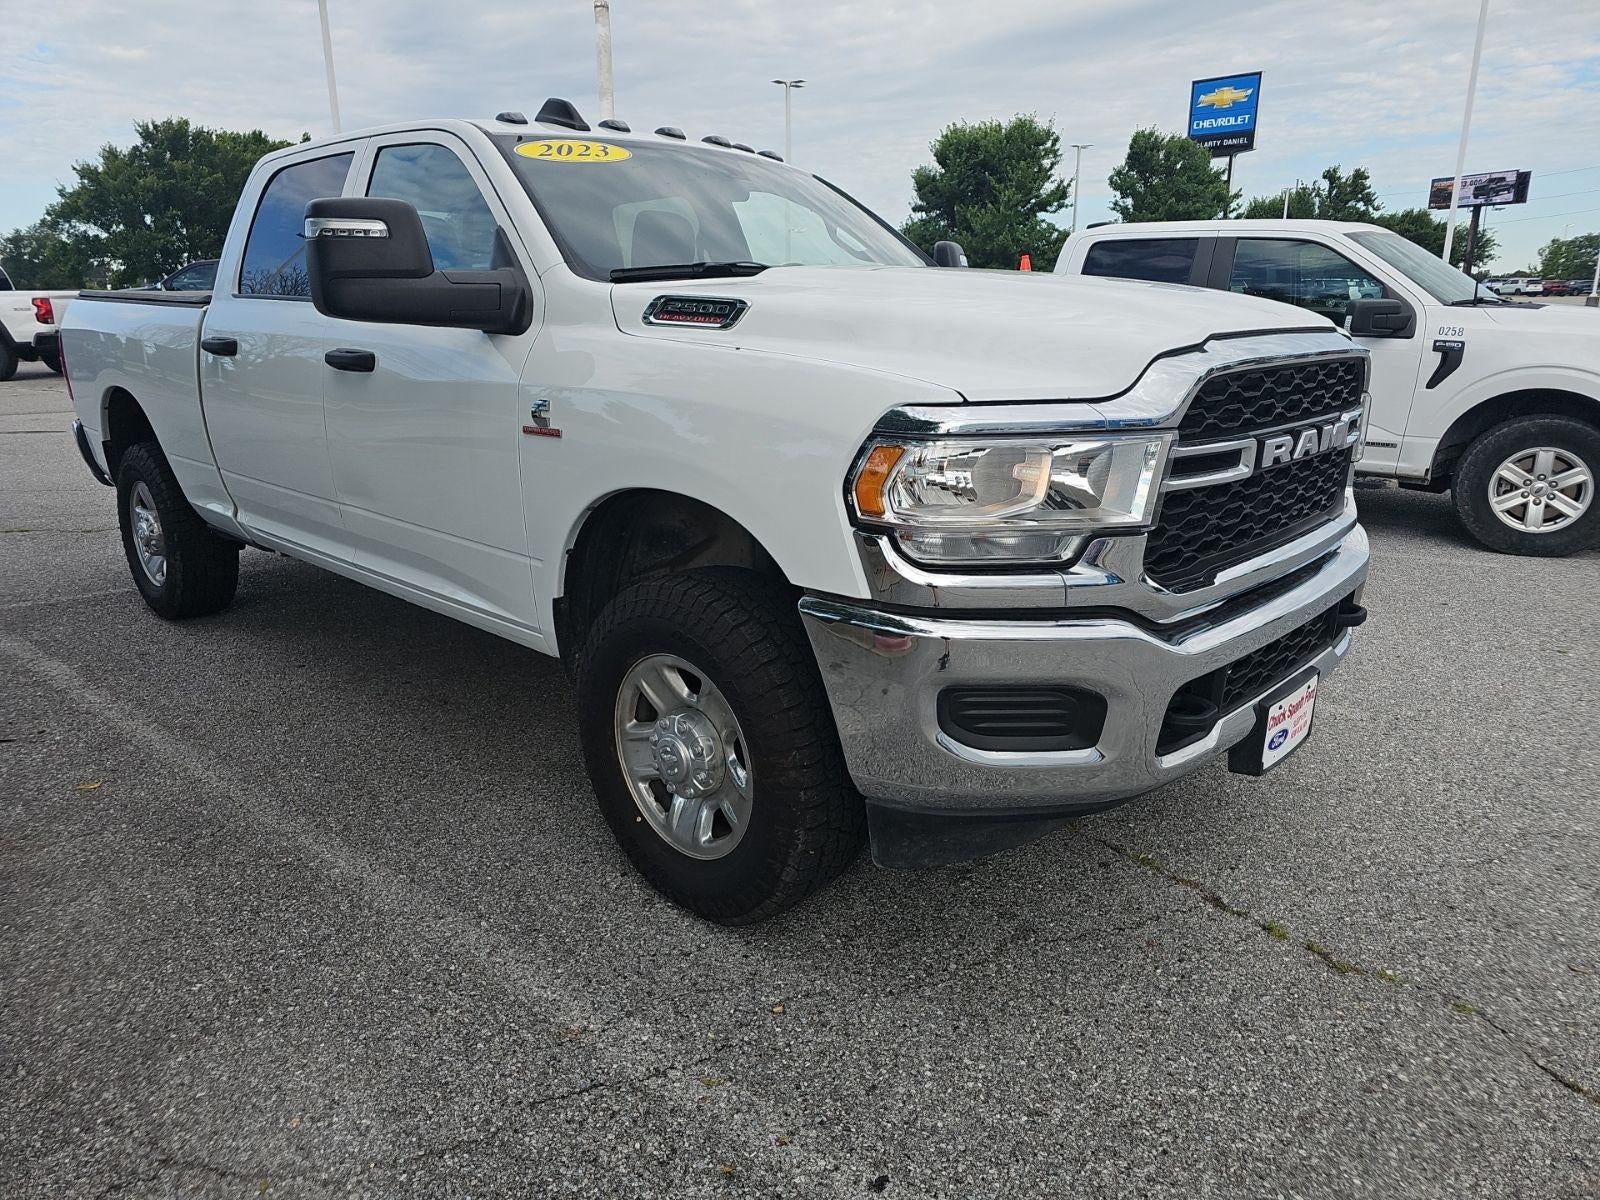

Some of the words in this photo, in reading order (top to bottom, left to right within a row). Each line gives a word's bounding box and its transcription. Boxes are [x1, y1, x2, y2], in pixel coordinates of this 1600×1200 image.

[1193, 115, 1250, 129] CHEVROLET
[1223, 137, 1248, 146] DANIEL
[538, 144, 609, 157] 2023
[664, 302, 730, 314] 2500
[659, 313, 693, 322] HEAVY
[694, 315, 724, 325] DUTY
[1438, 326, 1465, 337] 0258
[1261, 421, 1348, 468] RAM
